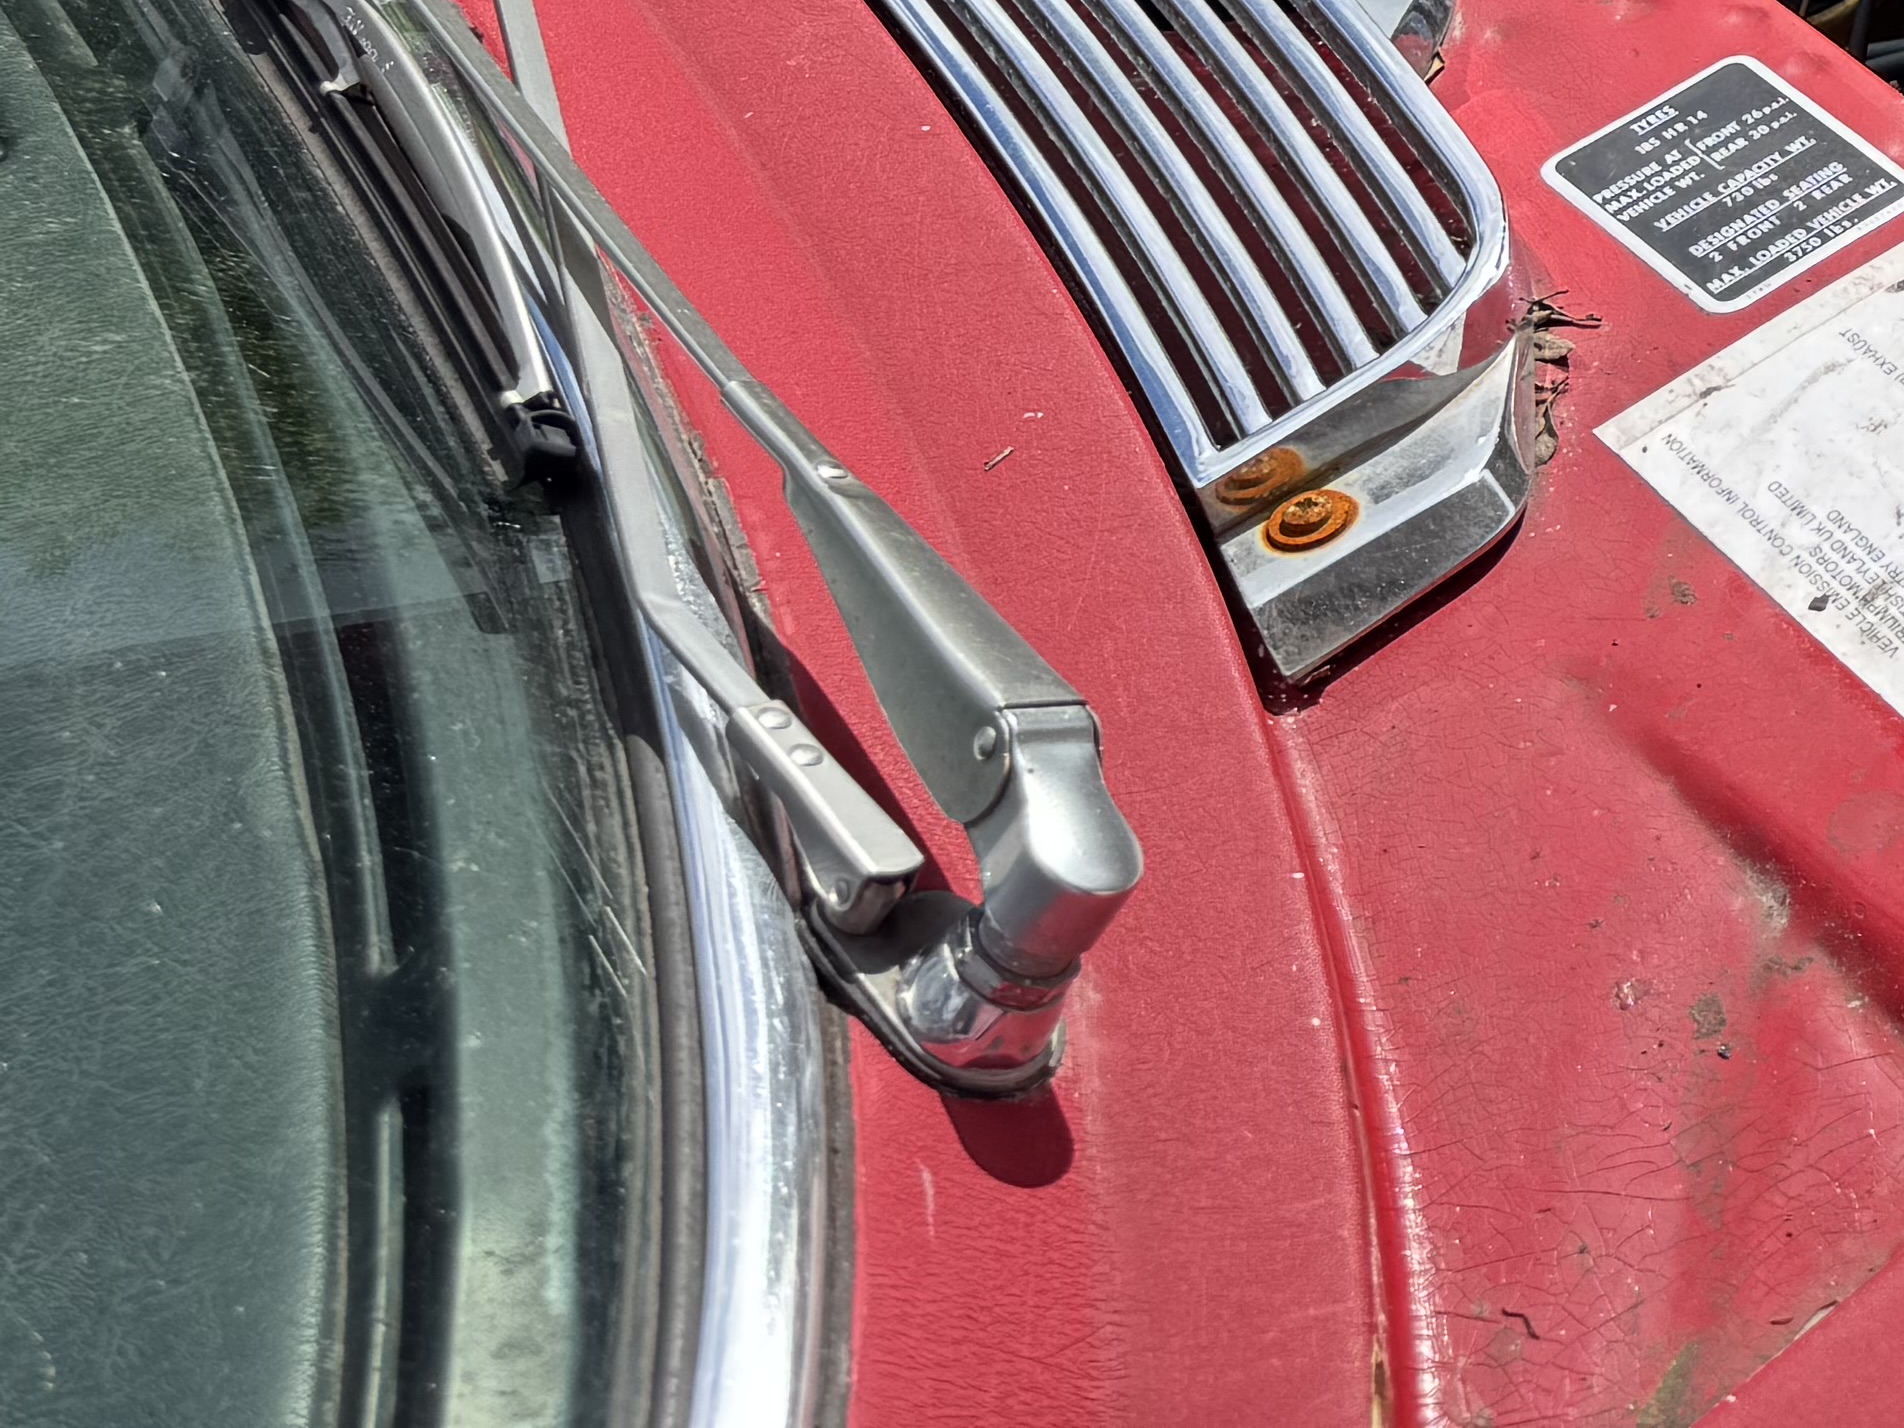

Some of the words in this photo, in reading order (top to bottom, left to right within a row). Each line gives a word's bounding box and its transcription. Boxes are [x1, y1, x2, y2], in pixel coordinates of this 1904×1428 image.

[1628, 104, 1678, 134] TYRES
[1633, 136, 1662, 154] 185
[1685, 109, 1710, 125] 14
[1694, 120, 1743, 151] FRONT
[1642, 154, 1702, 191] LOADED
[1709, 136, 1749, 162] REAR
[1591, 160, 1662, 204] PRESSURE
[1660, 148, 1684, 164] AT
[1616, 185, 1677, 223] VEHICLE
[1673, 168, 1706, 189] WT.
[1652, 190, 1717, 231] VEHICLE
[1715, 150, 1785, 194] CAPACITY
[1783, 133, 1816, 154] WT.
[1751, 170, 1780, 189] lbs
[1686, 197, 1783, 257] DESIGNATED
[1780, 159, 1845, 201] SEATING
[1704, 262, 1750, 293] MAX.
[1747, 226, 1809, 266] LOADED
[1806, 192, 1867, 231] VEHICLE
[1862, 175, 1897, 198] WT.
[1707, 250, 1725, 263] 2
[1726, 215, 1783, 251] FRONT
[1791, 200, 1808, 211] 2
[1810, 172, 1853, 200] REAR
[1838, 325, 1899, 375] EXHAUST
[1654, 431, 1744, 506] INFORMATION
[1762, 479, 1819, 525] LIMITED
[1728, 500, 1798, 558] CONTROL
[1806, 519, 1836, 542] UK
[1821, 508, 1888, 563] ENGLAND
[1783, 552, 1854, 611] EMISSION
[1804, 544, 1867, 596] MOTORS
[1825, 537, 1890, 591] LEYLAND
[1841, 605, 1904, 658] VEHICLE
